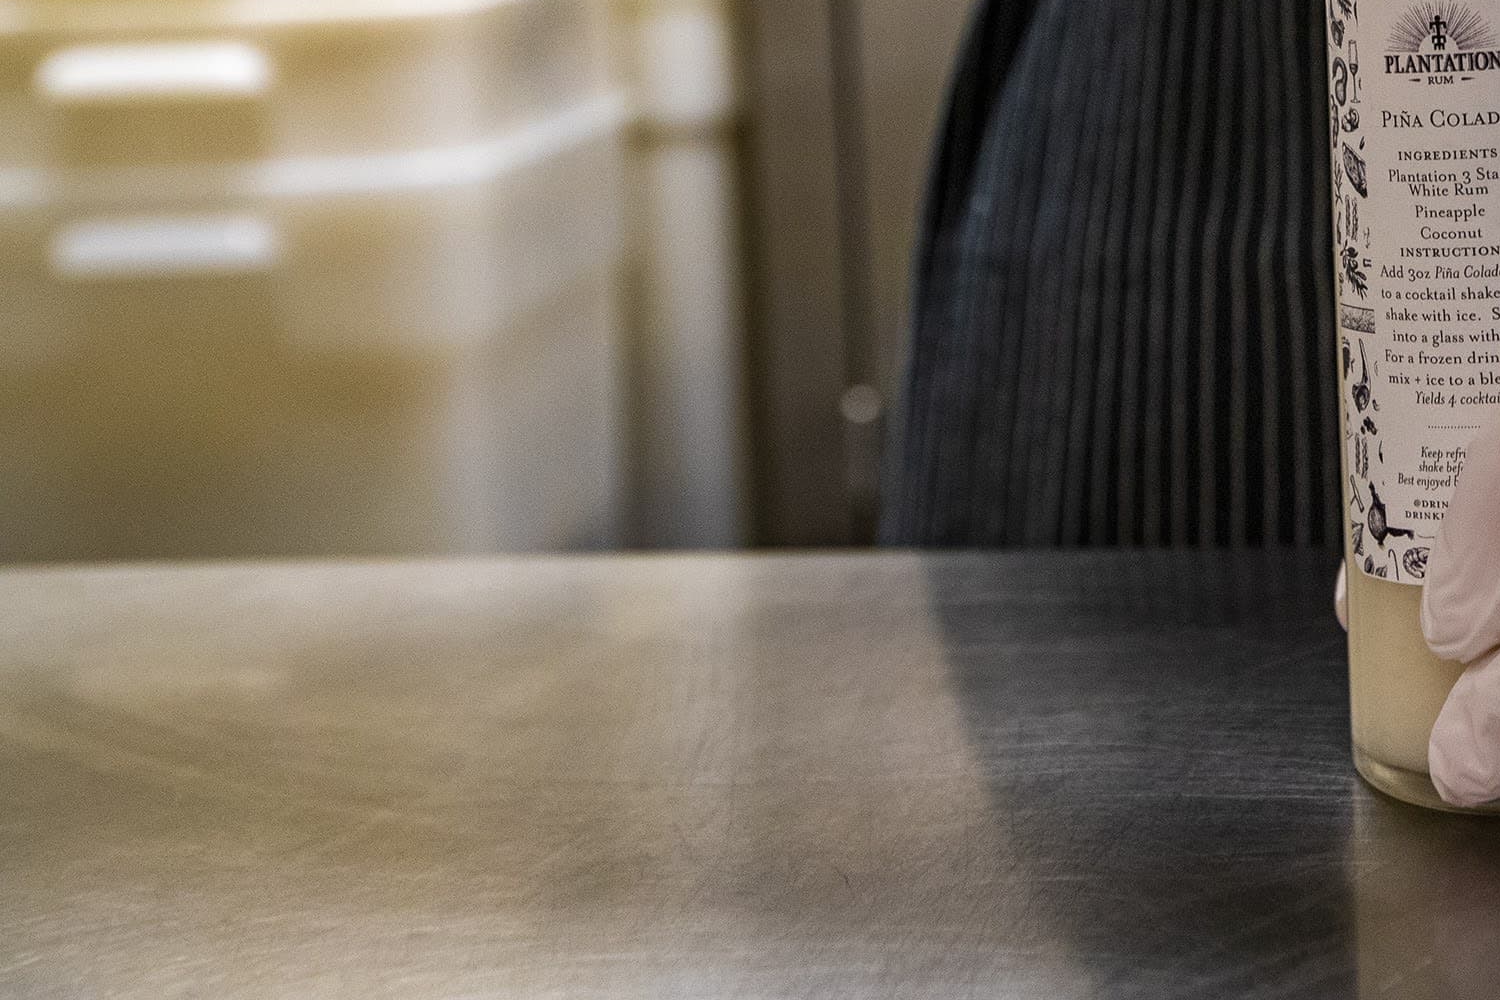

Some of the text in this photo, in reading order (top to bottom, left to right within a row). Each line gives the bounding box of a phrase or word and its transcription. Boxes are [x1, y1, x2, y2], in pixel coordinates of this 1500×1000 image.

[1428, 76, 1454, 85] RUM
[1399, 148, 1498, 161] INGREDIENTS
[1388, 169, 1457, 183] Plantation
[1463, 171, 1471, 184] 3
[1408, 182, 1489, 197] White Rum
[1415, 203, 1486, 222] Pineapple
[1420, 226, 1483, 240] Coconut
[1380, 265, 1404, 279] Add
[1408, 268, 1431, 282] 3oz
[1435, 266, 1460, 279] Piña
[1381, 289, 1392, 299] to
[1395, 291, 1401, 300] a
[1405, 287, 1456, 301] cocktail
[1385, 307, 1418, 322] shake
[1422, 308, 1451, 322] with
[1456, 310, 1482, 322] ice.
[1392, 330, 1417, 343] into
[1421, 335, 1428, 344] a
[1432, 330, 1465, 348] glass
[1469, 328, 1500, 343] with
[1385, 349, 1404, 363] For
[1408, 355, 1414, 364] a
[1418, 351, 1462, 365] frozen
[1389, 374, 1410, 385] mix
[1426, 374, 1445, 386] ice
[1450, 375, 1464, 386] to
[1468, 377, 1475, 386] a
[1415, 391, 1445, 405] Yields
[1449, 393, 1455, 408] 4
[1421, 446, 1466, 462] Keep refri
[1419, 461, 1464, 477] shake bef
[1398, 473, 1414, 485] Best
[1417, 475, 1451, 491] enjoyed
[1414, 499, 1449, 508] @DRIN
[1405, 511, 1445, 520] DRINK
